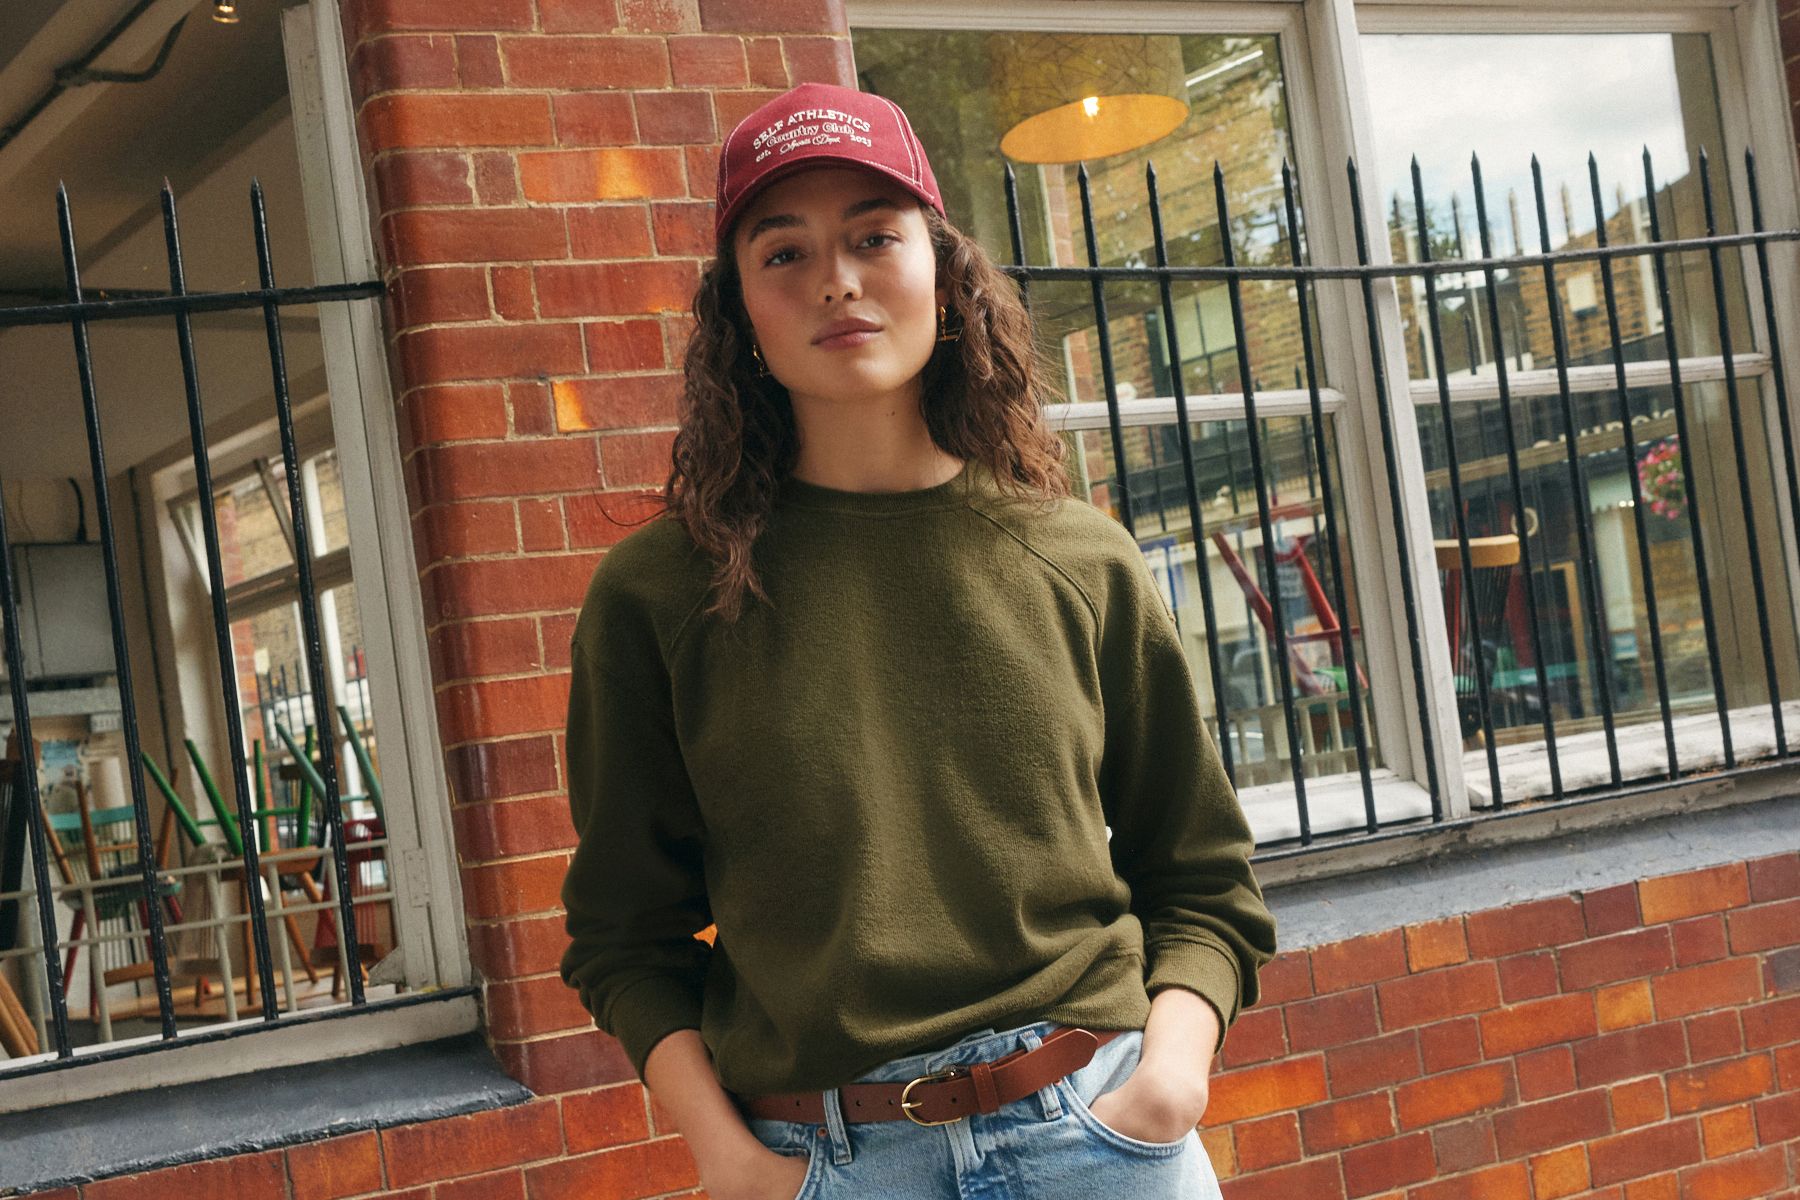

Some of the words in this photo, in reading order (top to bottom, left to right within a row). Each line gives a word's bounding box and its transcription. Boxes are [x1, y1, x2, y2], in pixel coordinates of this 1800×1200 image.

[753, 120, 783, 149] SELF
[787, 109, 871, 132] ATHLETICS
[766, 125, 819, 147] Country
[822, 122, 855, 135] Club
[850, 134, 872, 148] 2023
